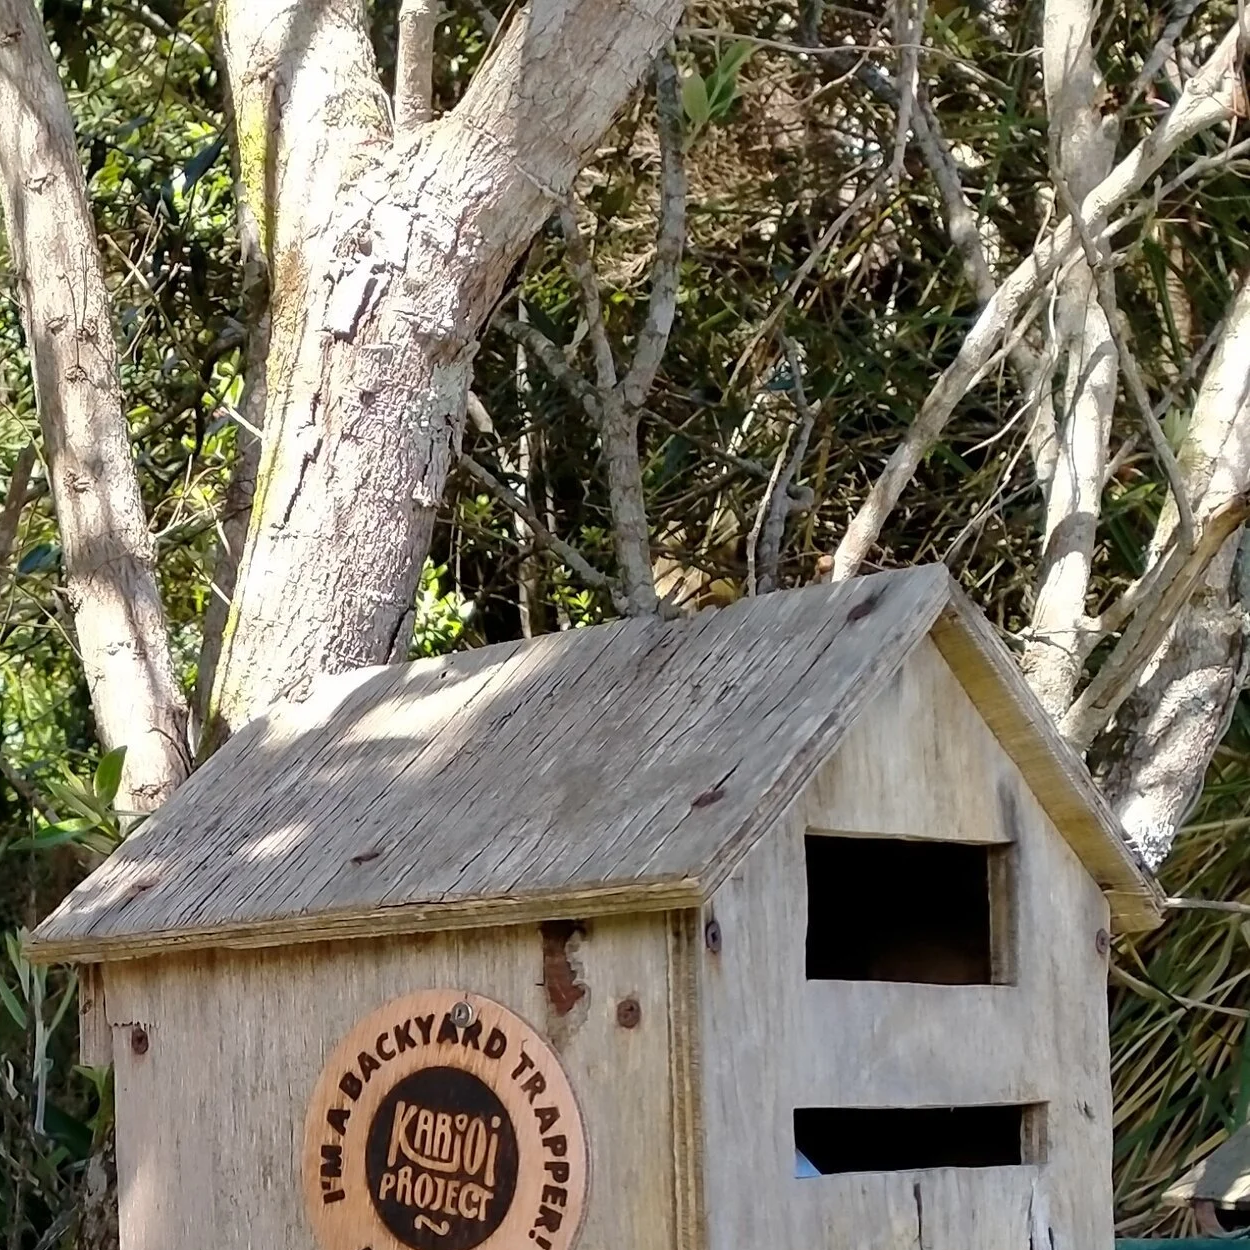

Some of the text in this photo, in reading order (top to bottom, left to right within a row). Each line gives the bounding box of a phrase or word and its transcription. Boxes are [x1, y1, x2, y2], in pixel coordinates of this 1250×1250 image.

[339, 1012, 507, 1101] BACKYARD
[327, 1108, 350, 1136] A
[321, 1144, 345, 1204] I'M
[379, 1166, 494, 1222] PROJECT
